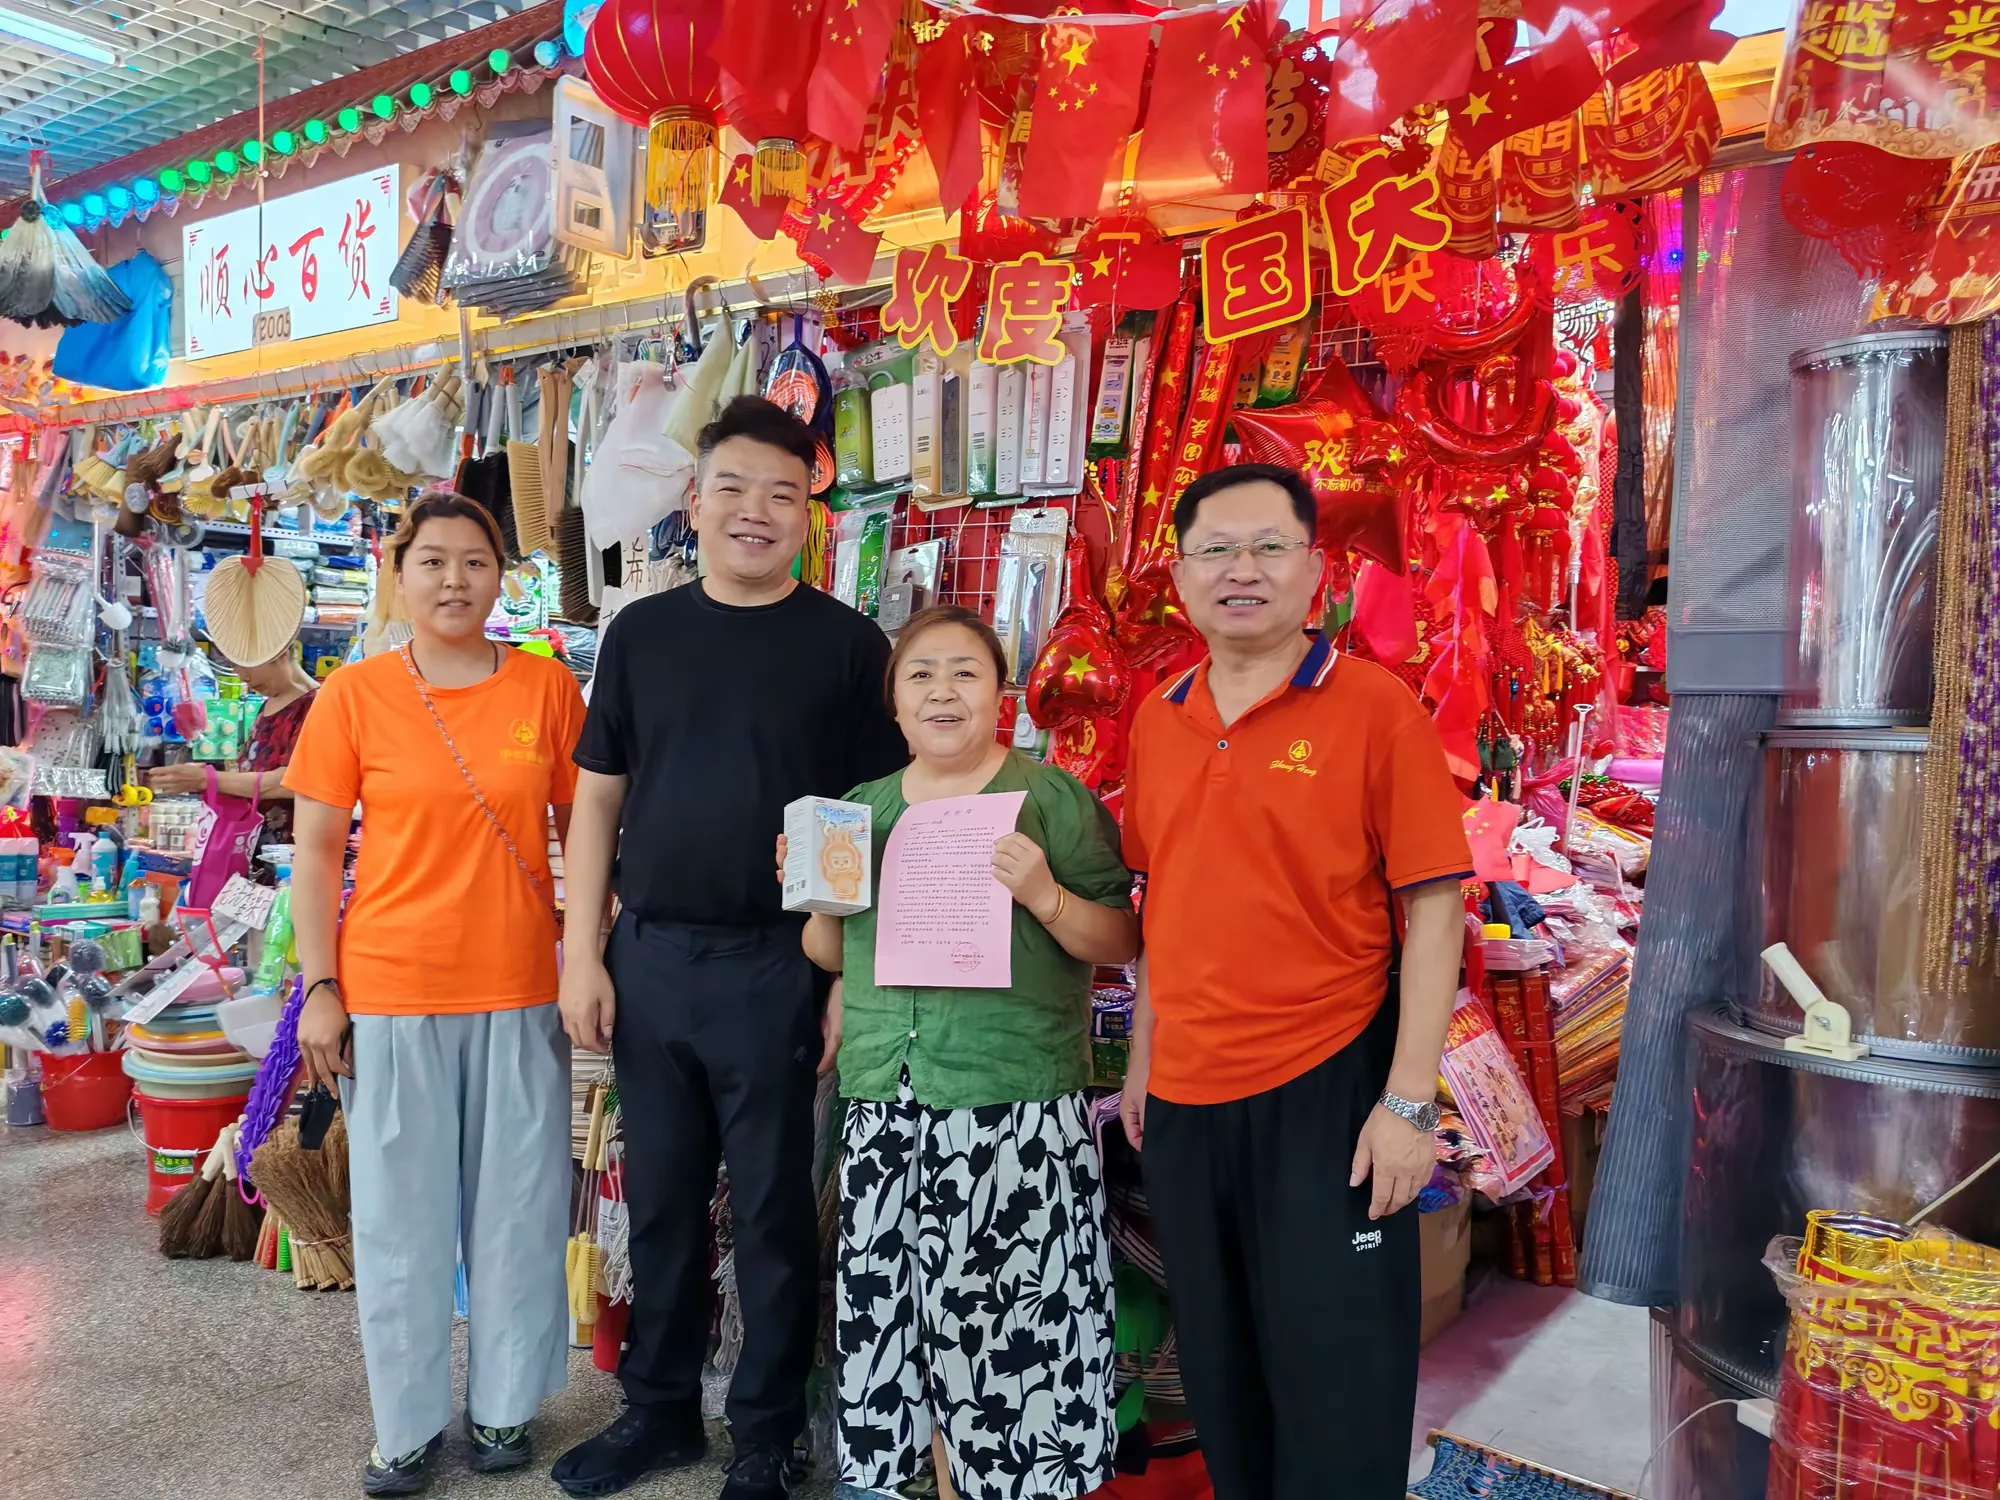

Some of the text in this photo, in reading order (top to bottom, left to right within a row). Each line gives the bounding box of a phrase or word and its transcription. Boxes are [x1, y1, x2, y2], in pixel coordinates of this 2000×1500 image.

[200, 198, 376, 325] 顺心百货
[1551, 219, 1623, 293] 乐
[1314, 476, 1363, 492] 不忘初心
[1352, 1229, 1382, 1245] Jeep
[1355, 1241, 1379, 1252] SPIRIT
